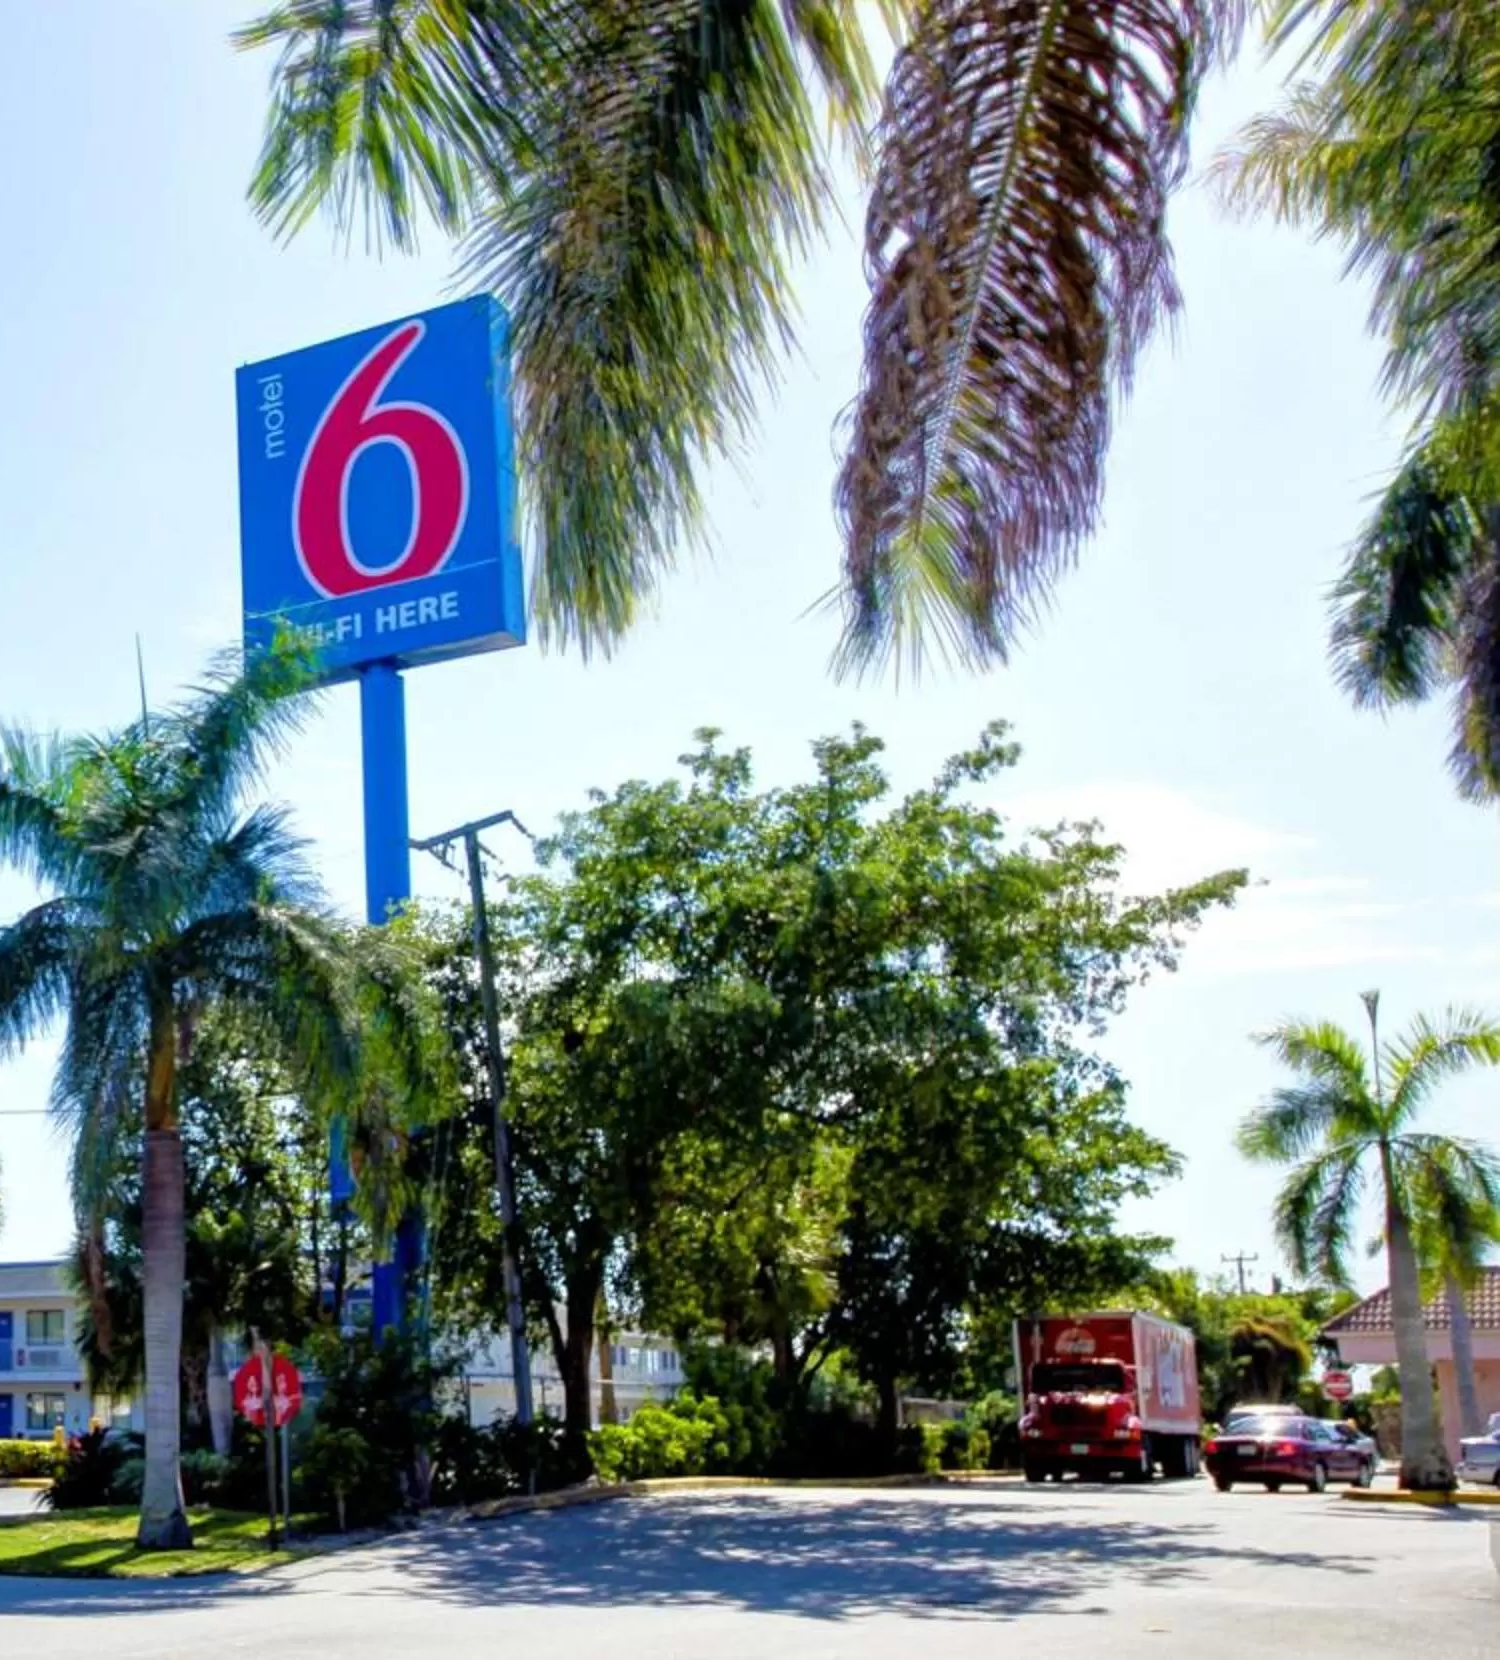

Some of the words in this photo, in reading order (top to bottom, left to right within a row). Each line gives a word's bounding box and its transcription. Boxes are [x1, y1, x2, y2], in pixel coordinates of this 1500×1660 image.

[257, 373, 286, 459] motel
[291, 318, 470, 600] 6
[375, 591, 460, 634] HERE
